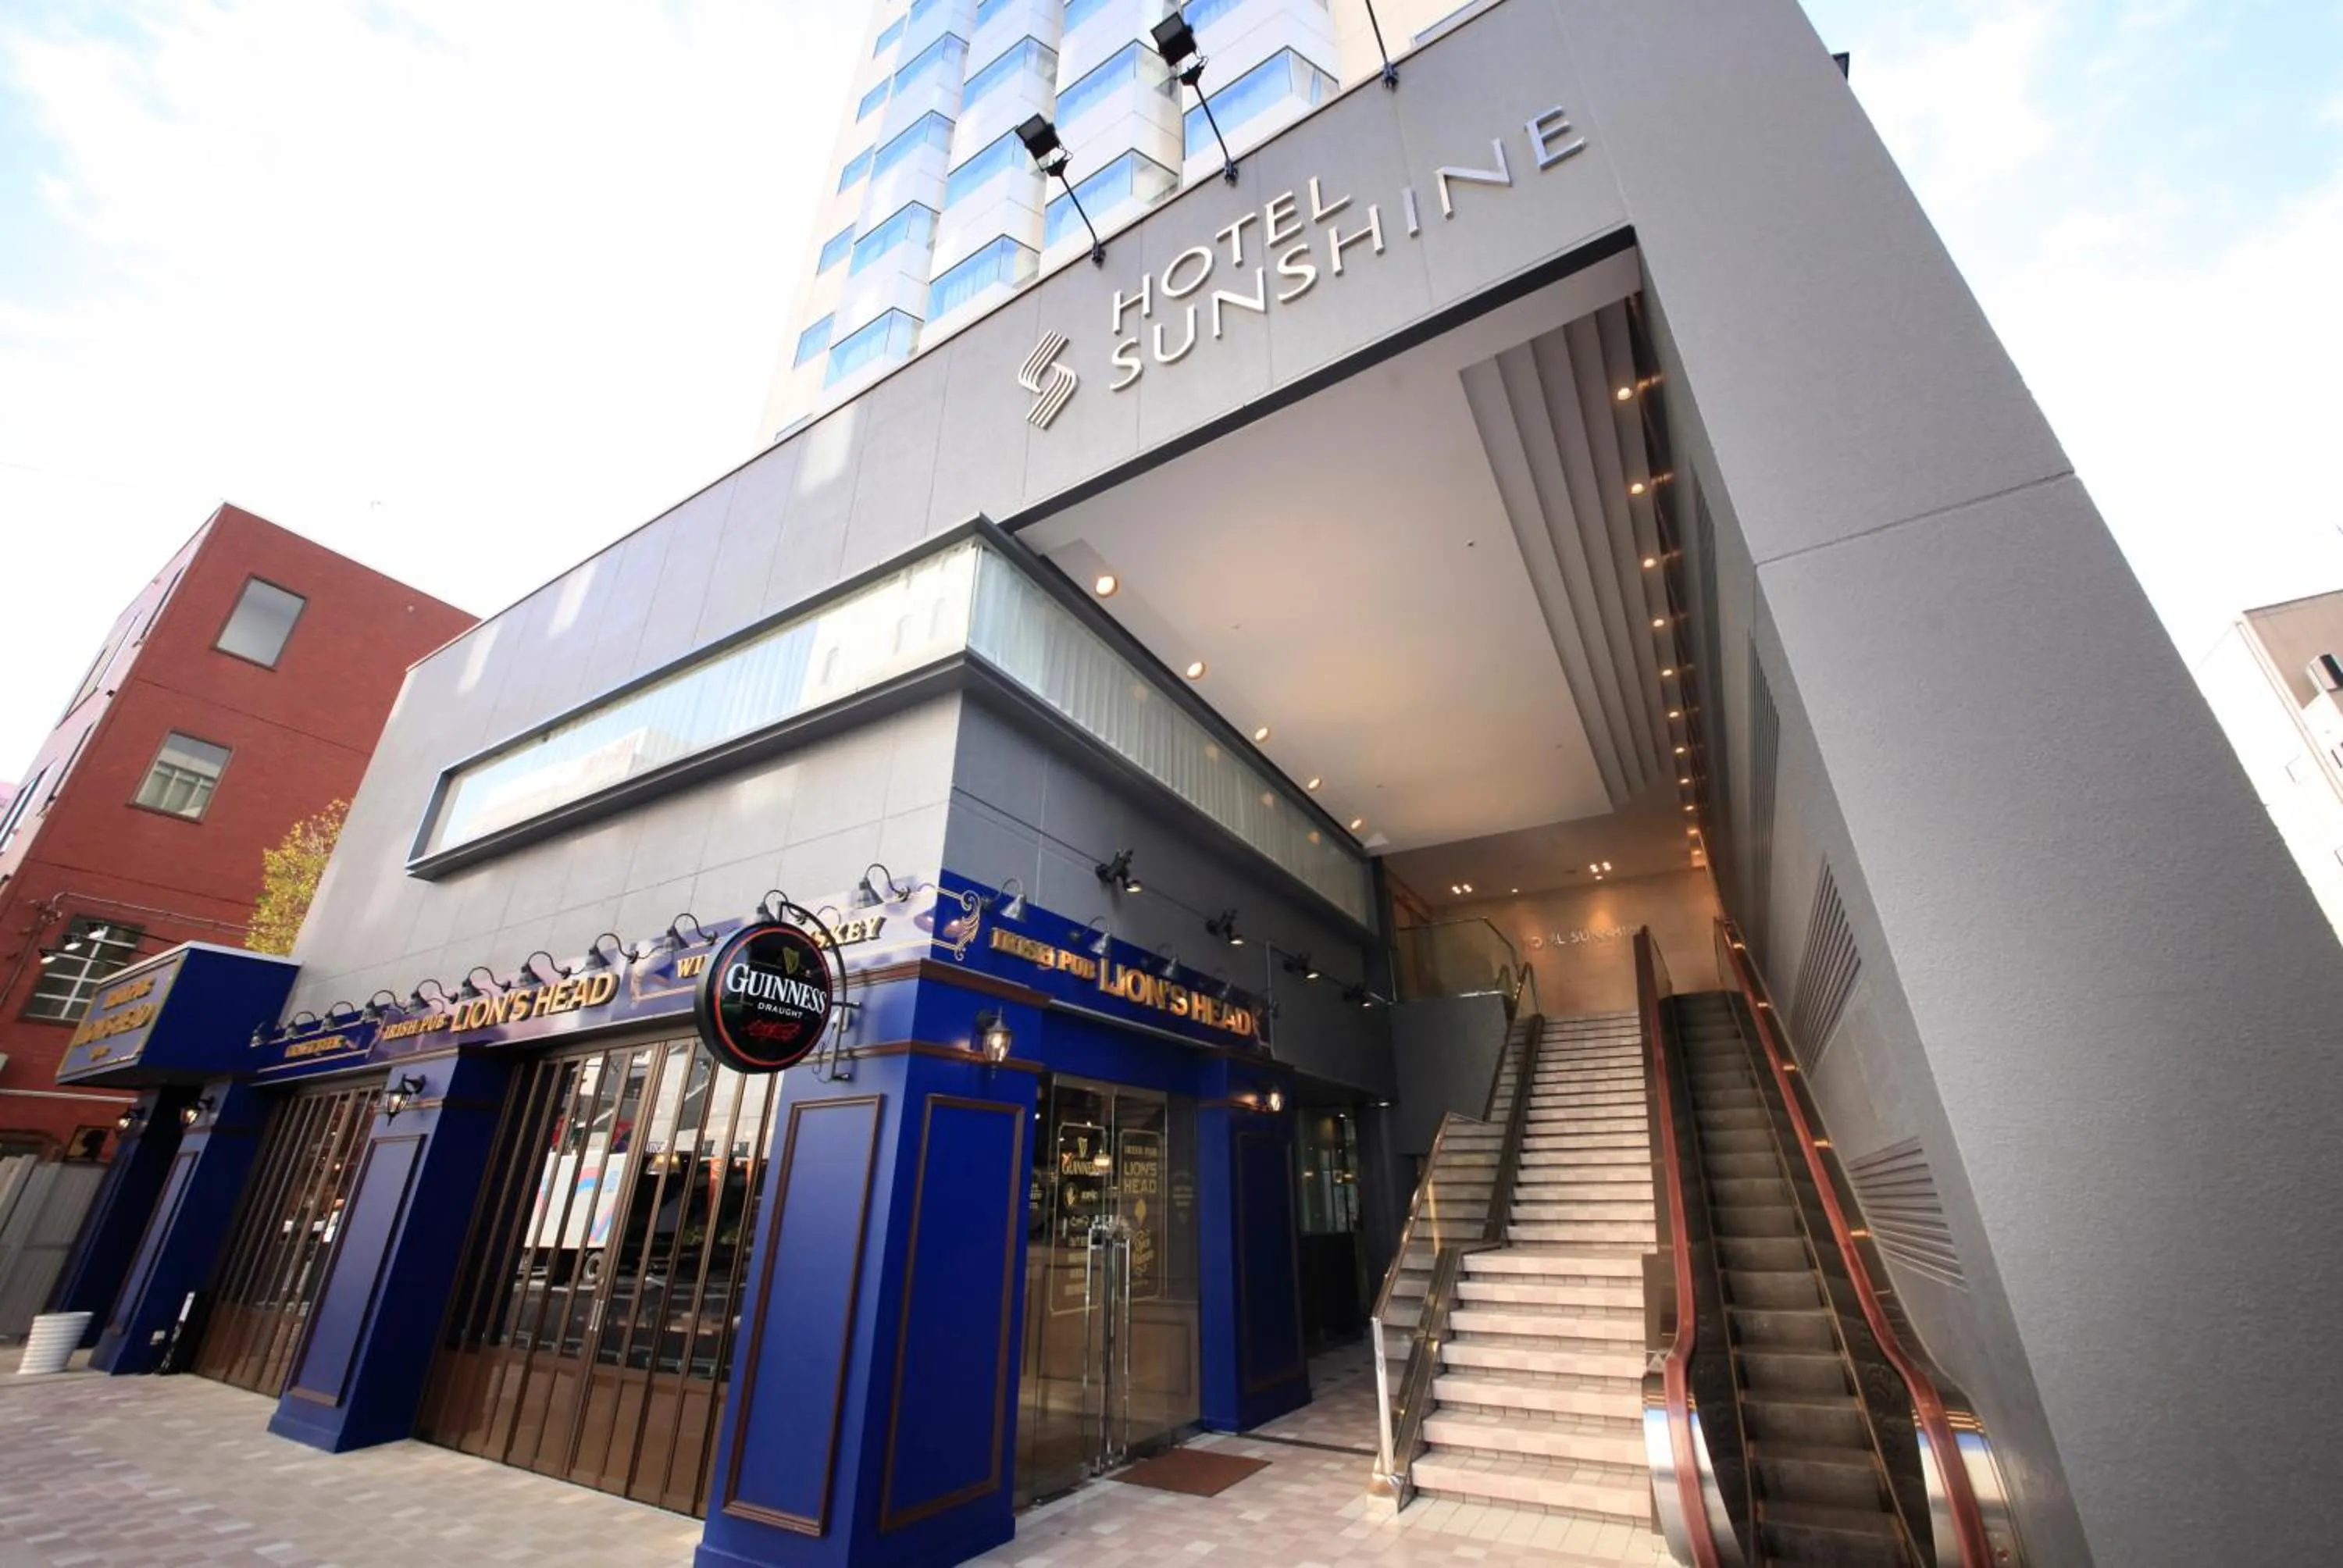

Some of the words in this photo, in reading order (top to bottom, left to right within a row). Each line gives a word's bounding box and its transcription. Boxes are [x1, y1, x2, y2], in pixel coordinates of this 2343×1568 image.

[1109, 105, 1587, 392] SUNSHINE
[1111, 175, 1352, 336] HOTEL
[382, 1019, 419, 1041] IRISH
[420, 1014, 450, 1033] PUB
[450, 989, 533, 1032] LION'S
[532, 971, 619, 1017] HEAD
[726, 962, 828, 1014] GUINNESS
[757, 1001, 804, 1020] DRAUGHT
[1189, 990, 1253, 1036] HEAD
[1123, 1178, 1157, 1194] HEAD
